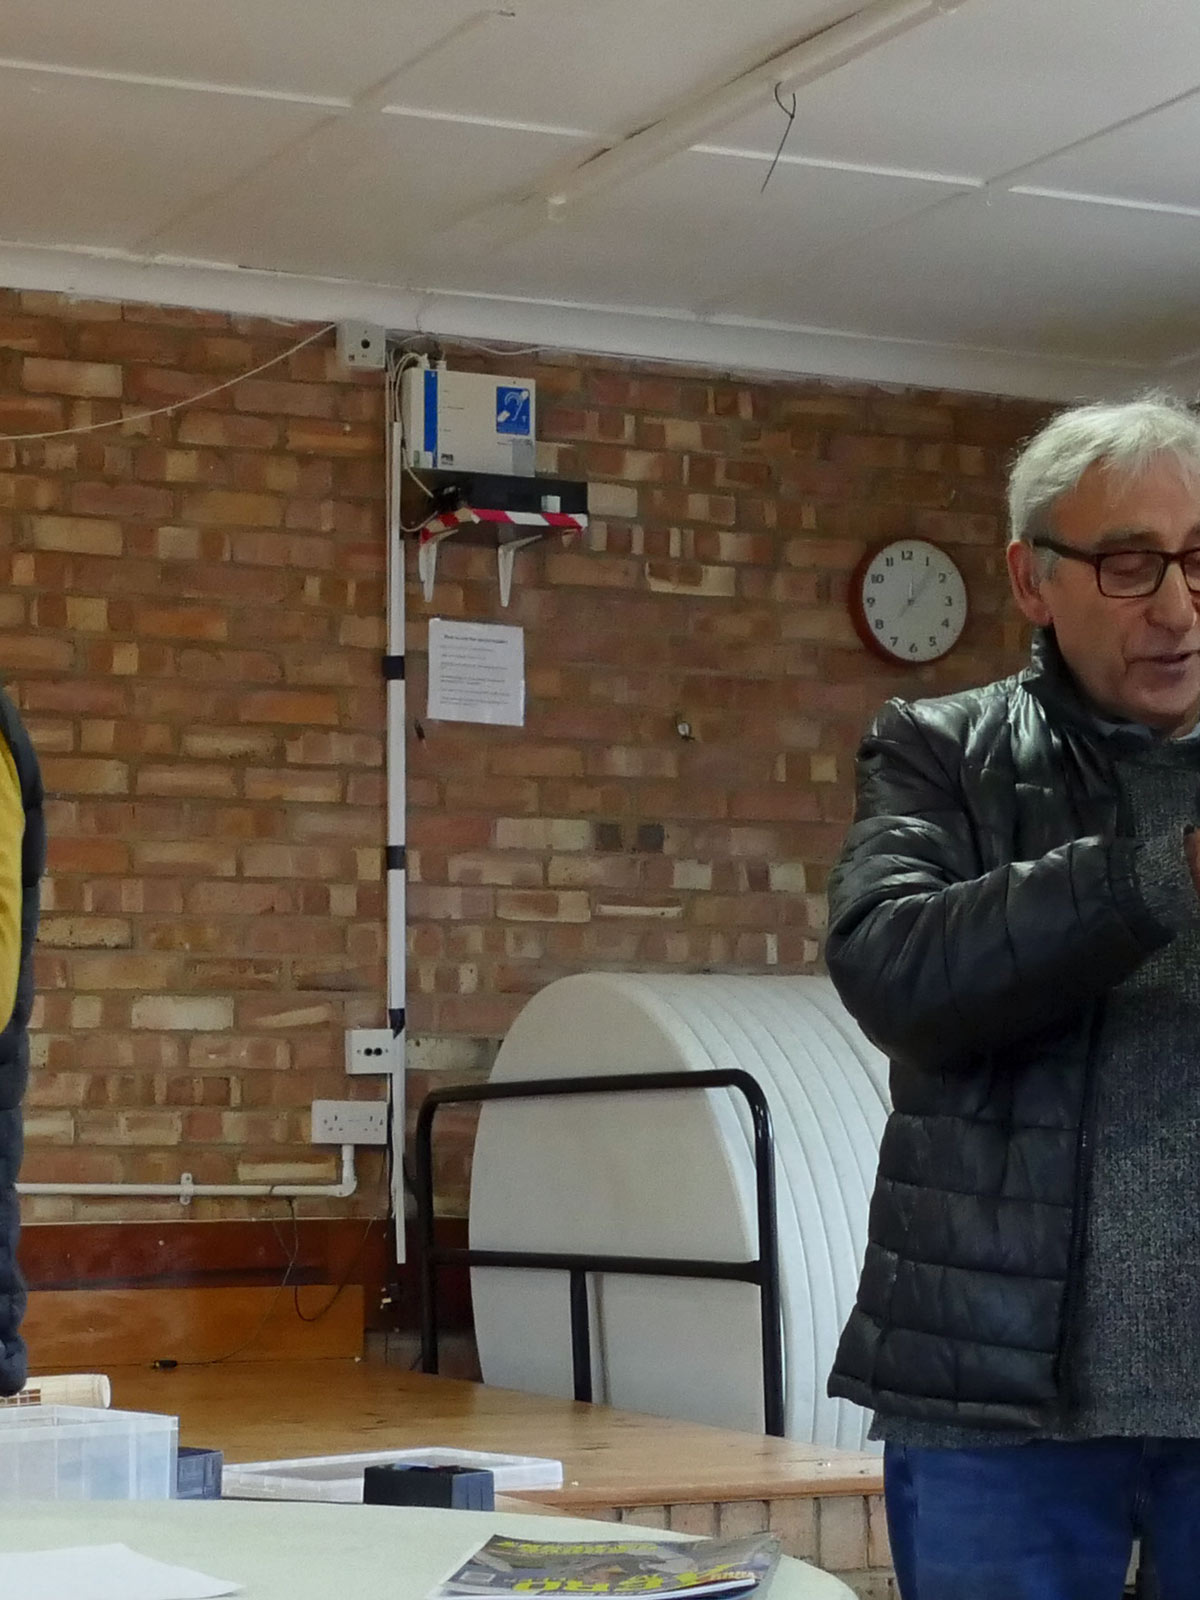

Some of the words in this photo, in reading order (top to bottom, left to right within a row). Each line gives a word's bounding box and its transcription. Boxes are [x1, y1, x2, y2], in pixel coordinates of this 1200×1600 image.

[901, 550, 913, 561] 12
[885, 557, 894, 567] 11
[871, 574, 884, 584] 10
[938, 573, 946, 583] 2
[867, 597, 876, 607] 9
[945, 596, 953, 607] 3
[875, 619, 884, 629] 8
[941, 618, 949, 628] 4
[890, 636, 899, 647] 7
[929, 637, 937, 647] 5
[909, 643, 918, 653] 6
